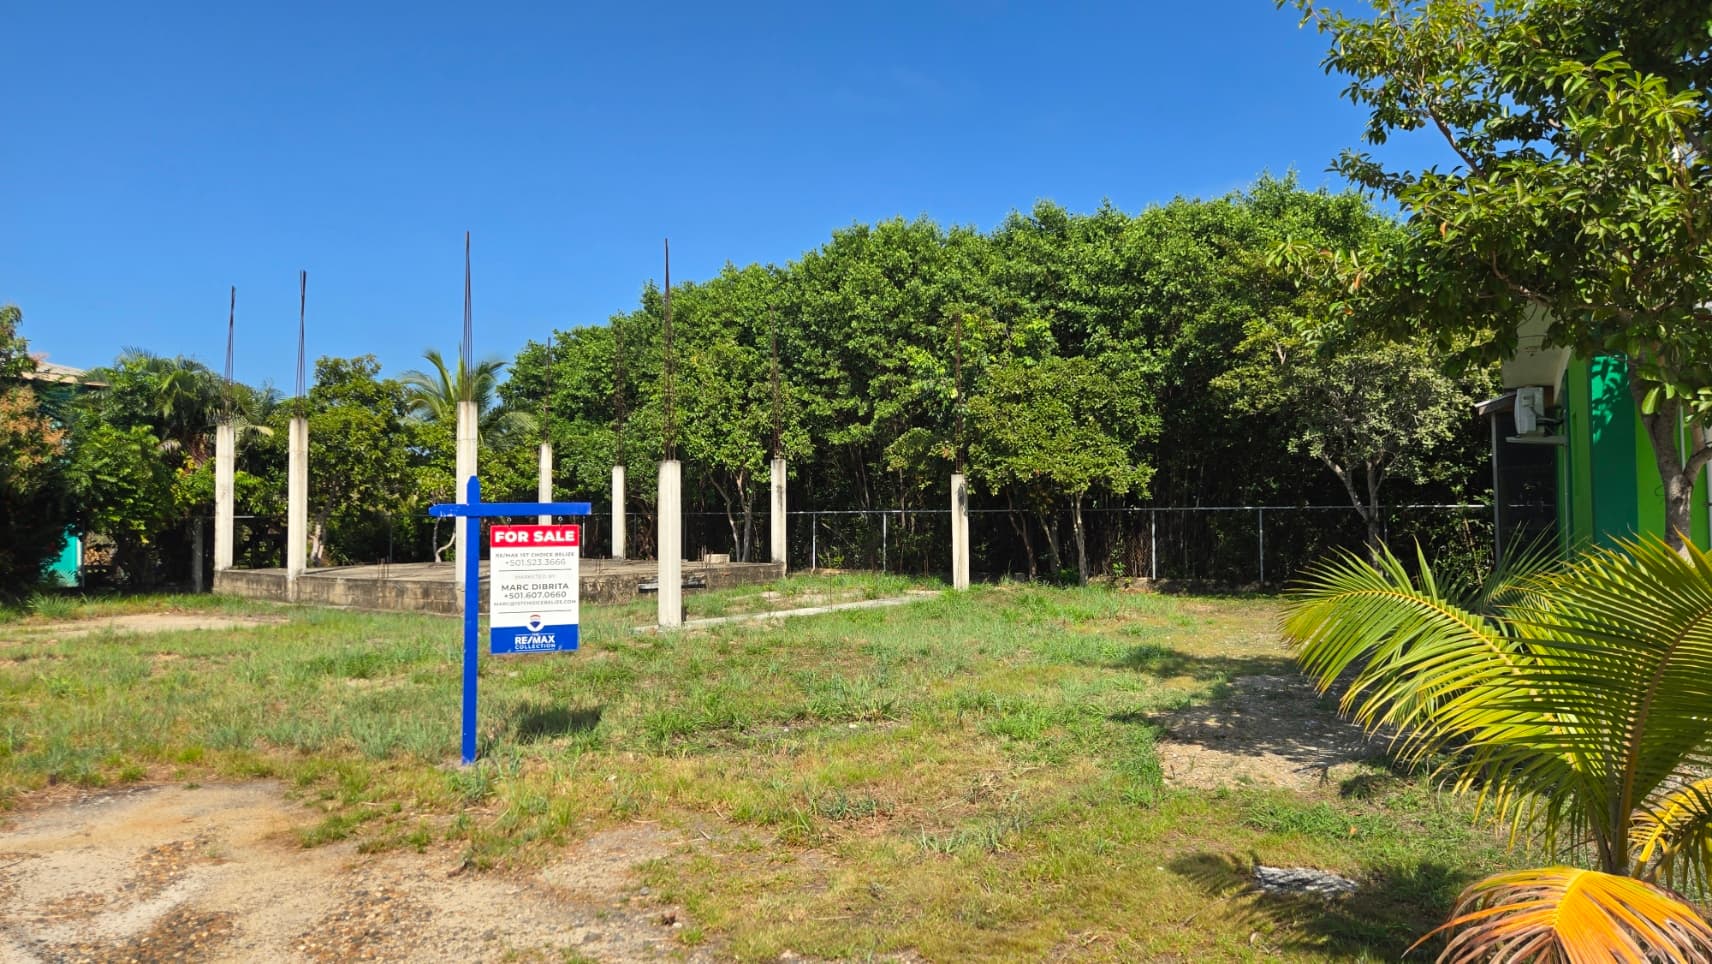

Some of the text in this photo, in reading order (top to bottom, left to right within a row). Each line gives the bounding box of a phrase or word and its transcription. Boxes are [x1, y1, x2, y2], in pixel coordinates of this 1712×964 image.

[494, 530, 575, 543] FOR SALE
[504, 591, 567, 600] +501.607.0660
[514, 635, 555, 645] RE/MAX
